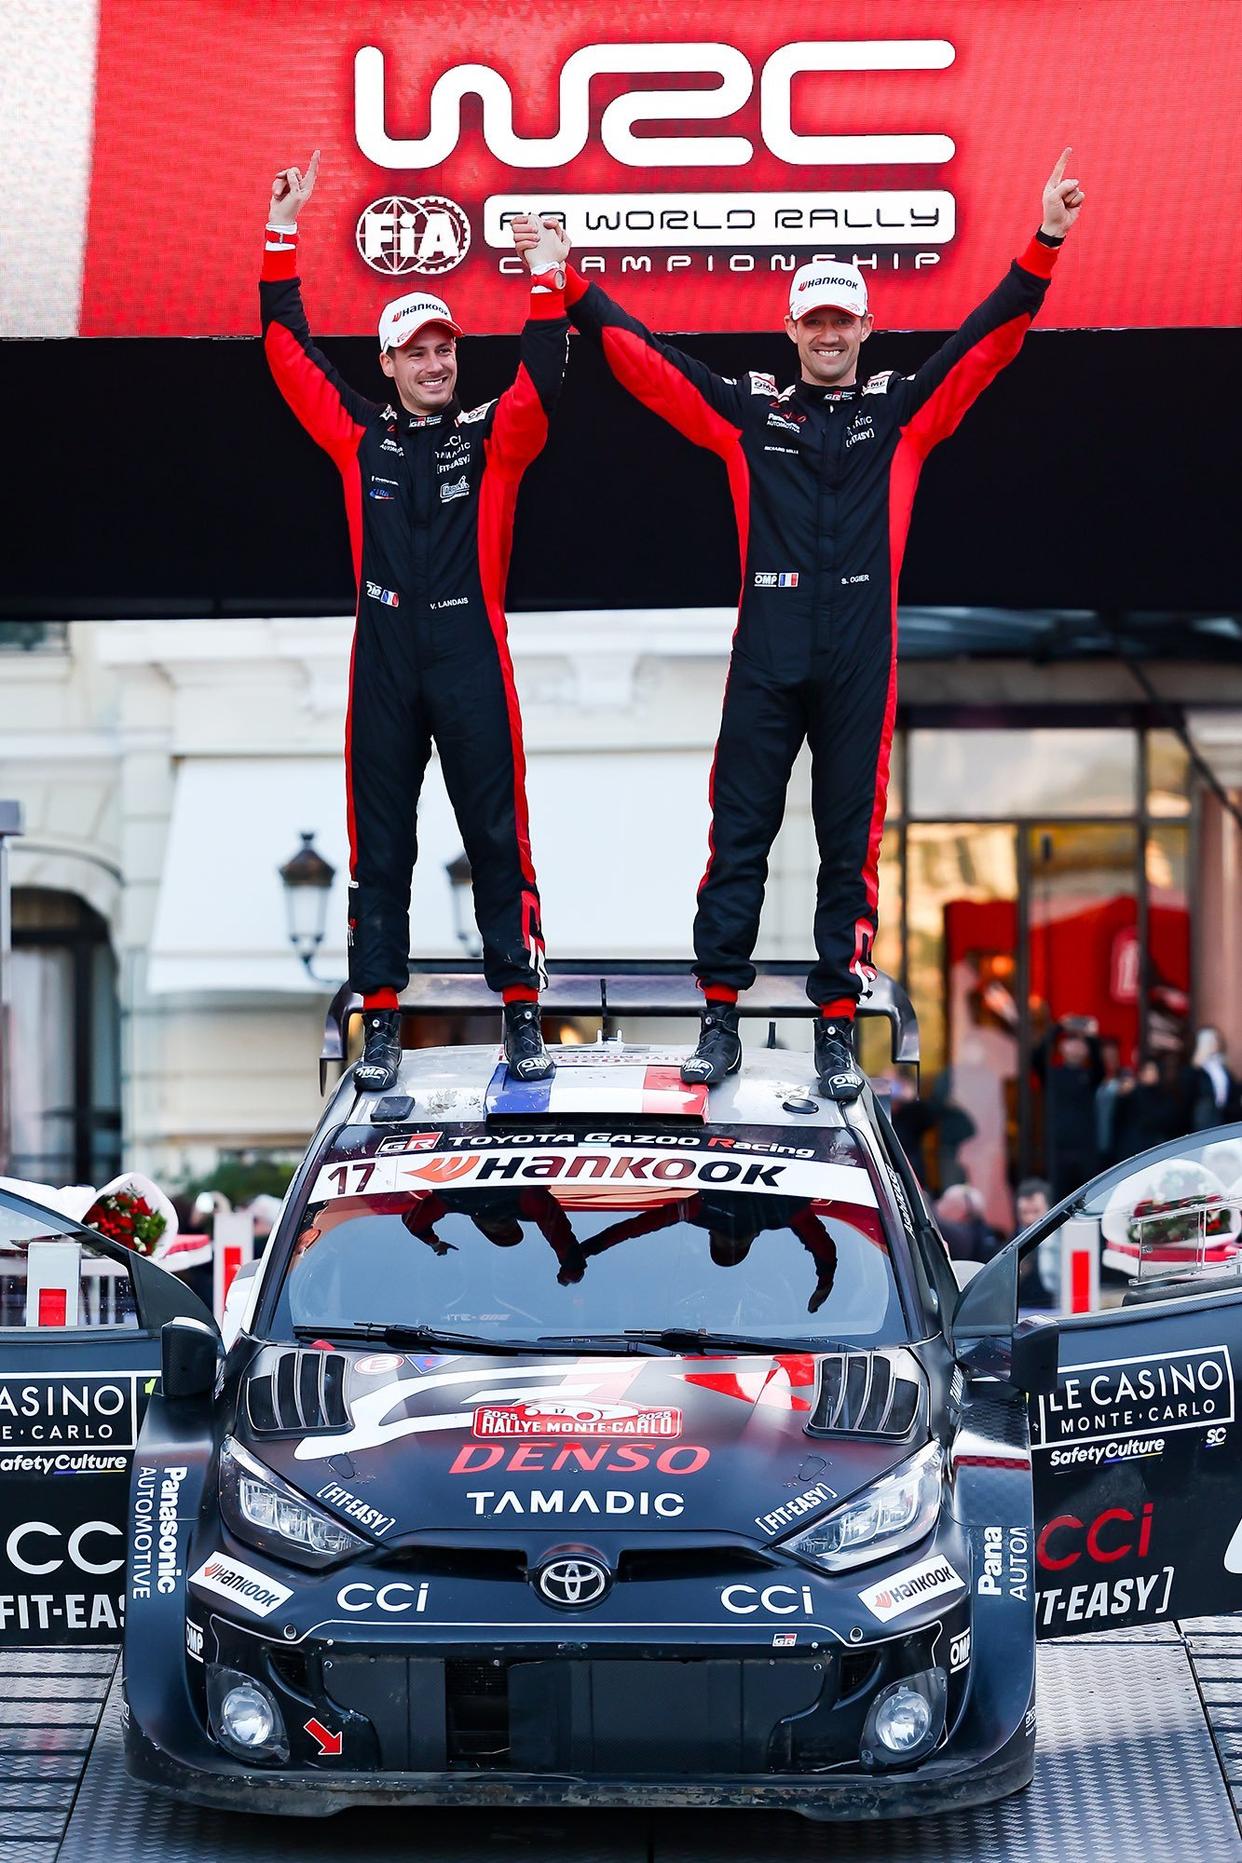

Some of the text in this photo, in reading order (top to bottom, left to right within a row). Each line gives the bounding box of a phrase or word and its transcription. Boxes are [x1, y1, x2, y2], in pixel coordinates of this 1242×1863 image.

[354, 39, 956, 169] WRC
[500, 206, 940, 231] FA WORLD RALLY
[499, 252, 941, 274] CAMPIONHIP
[438, 597, 469, 608] LANDAIS
[380, 1132, 815, 1158] GR TOYOTA GAZOO Racing
[328, 1163, 376, 1195] 17
[0, 1385, 124, 1417] ASINO
[1049, 1360, 1223, 1412] LE CASINO
[481, 1418, 673, 1434] RALLYE MONTE-CARLO
[484, 1409, 518, 1421] 2025
[637, 1410, 672, 1421] 2025
[1061, 1399, 1215, 1434] MONTE CARLO
[31, 1424, 113, 1440] CARLO
[1205, 1427, 1227, 1444] SC
[0, 1453, 128, 1475] afetyCulture
[448, 1443, 711, 1475] DENSO
[1050, 1438, 1166, 1467] SafetyCulture
[316, 1481, 397, 1536] [FIT-EASY]
[466, 1490, 685, 1517] TAMADIC
[754, 1482, 838, 1536] [FIT-EASY]
[132, 1466, 157, 1600] AUTOMOTIVE
[157, 1466, 188, 1594] Panasonic
[6, 1520, 126, 1575] CC
[336, 1582, 429, 1613] CCi
[721, 1583, 814, 1615] CCi
[773, 1635, 796, 1646] GR
